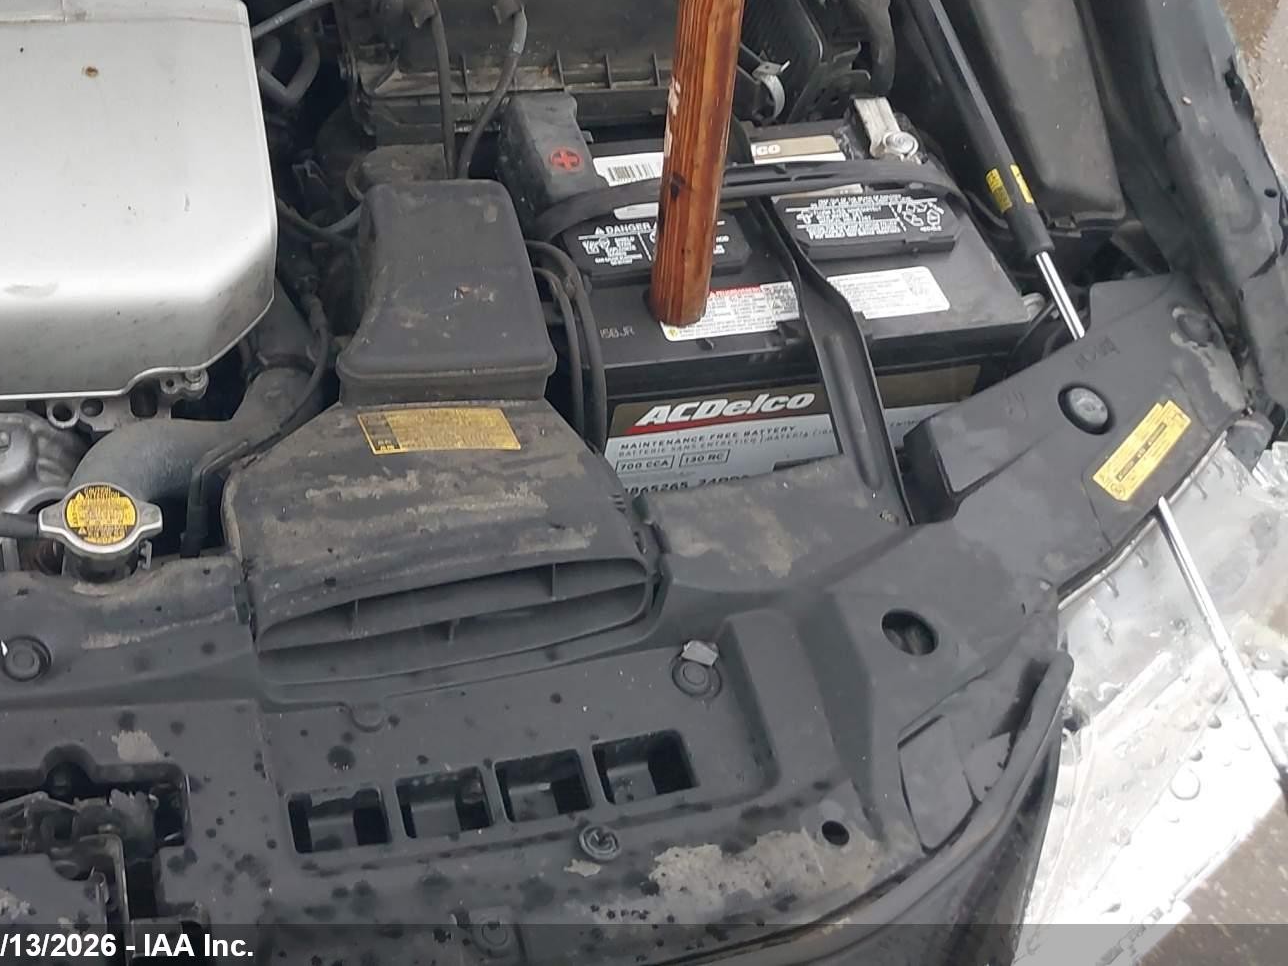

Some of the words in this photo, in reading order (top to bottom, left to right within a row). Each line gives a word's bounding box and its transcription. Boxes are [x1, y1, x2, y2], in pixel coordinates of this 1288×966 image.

[605, 221, 652, 235] DANGER
[633, 393, 817, 427] ACDelco
[620, 435, 704, 450] MAINTENANCE
[709, 431, 738, 440] FREE
[743, 425, 797, 437] BATTERY
[620, 461, 643, 471] 700
[646, 459, 669, 469] CCA
